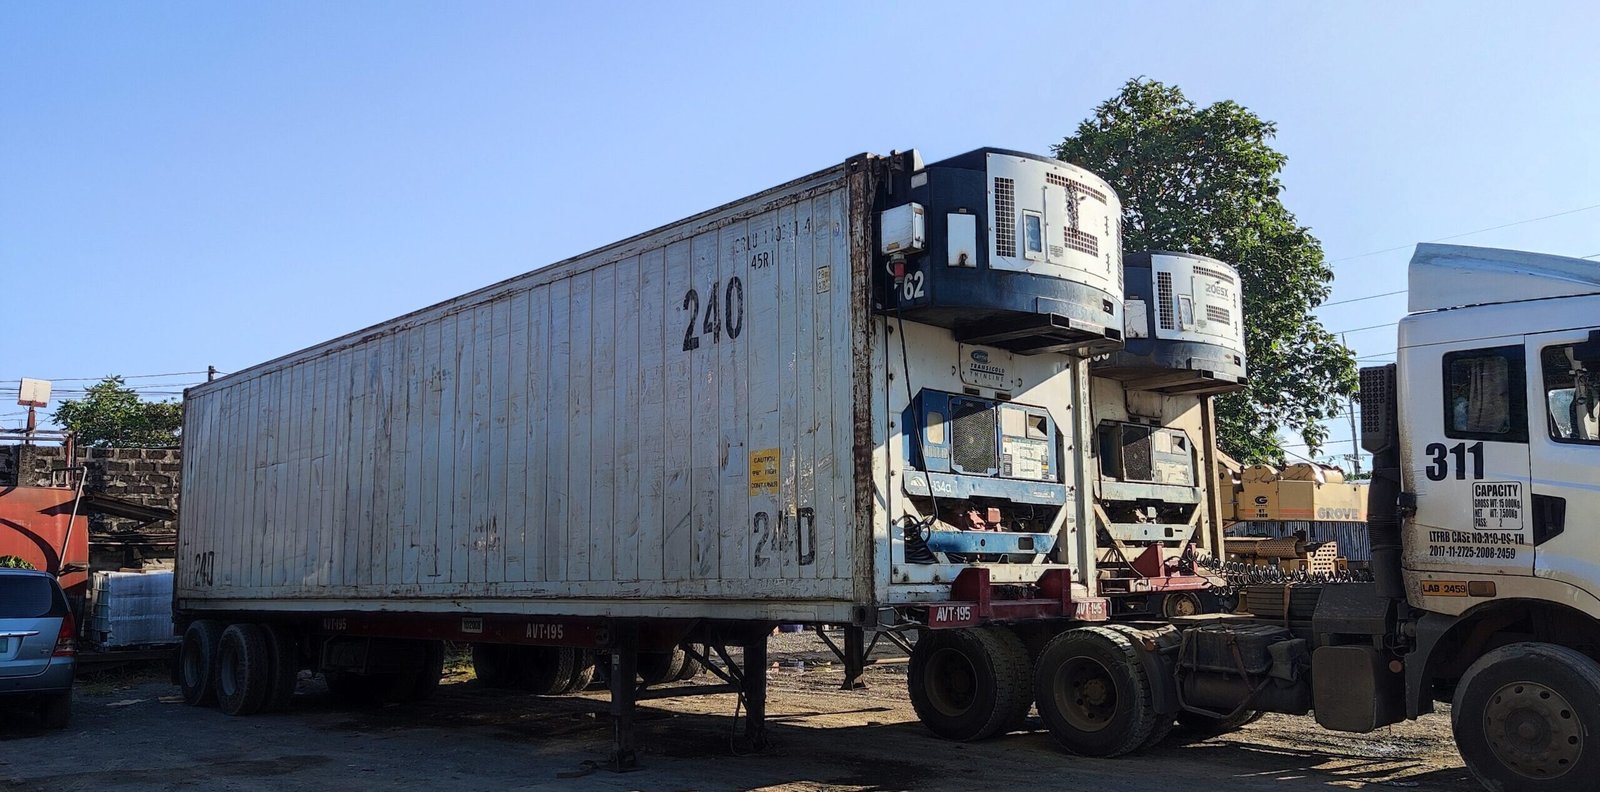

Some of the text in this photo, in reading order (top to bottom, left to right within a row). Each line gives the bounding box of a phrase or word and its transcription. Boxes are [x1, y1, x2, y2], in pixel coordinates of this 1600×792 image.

[751, 250, 775, 270] 45R1
[682, 276, 744, 352] 240
[970, 363, 1005, 374] TRANSICOLD
[1425, 441, 1485, 481] 311
[1475, 484, 1518, 497] CAPACITY
[1474, 499, 1489, 508] GROSS
[1317, 507, 1359, 520] GROVE
[1499, 518, 1503, 527] 2
[1429, 531, 1450, 542] LTFRB
[1452, 531, 1471, 543] CASE
[195, 550, 215, 587] 240
[1423, 585, 1466, 593] LAB 2459
[936, 606, 971, 622] AVT-195
[526, 622, 564, 640] AVT-195
